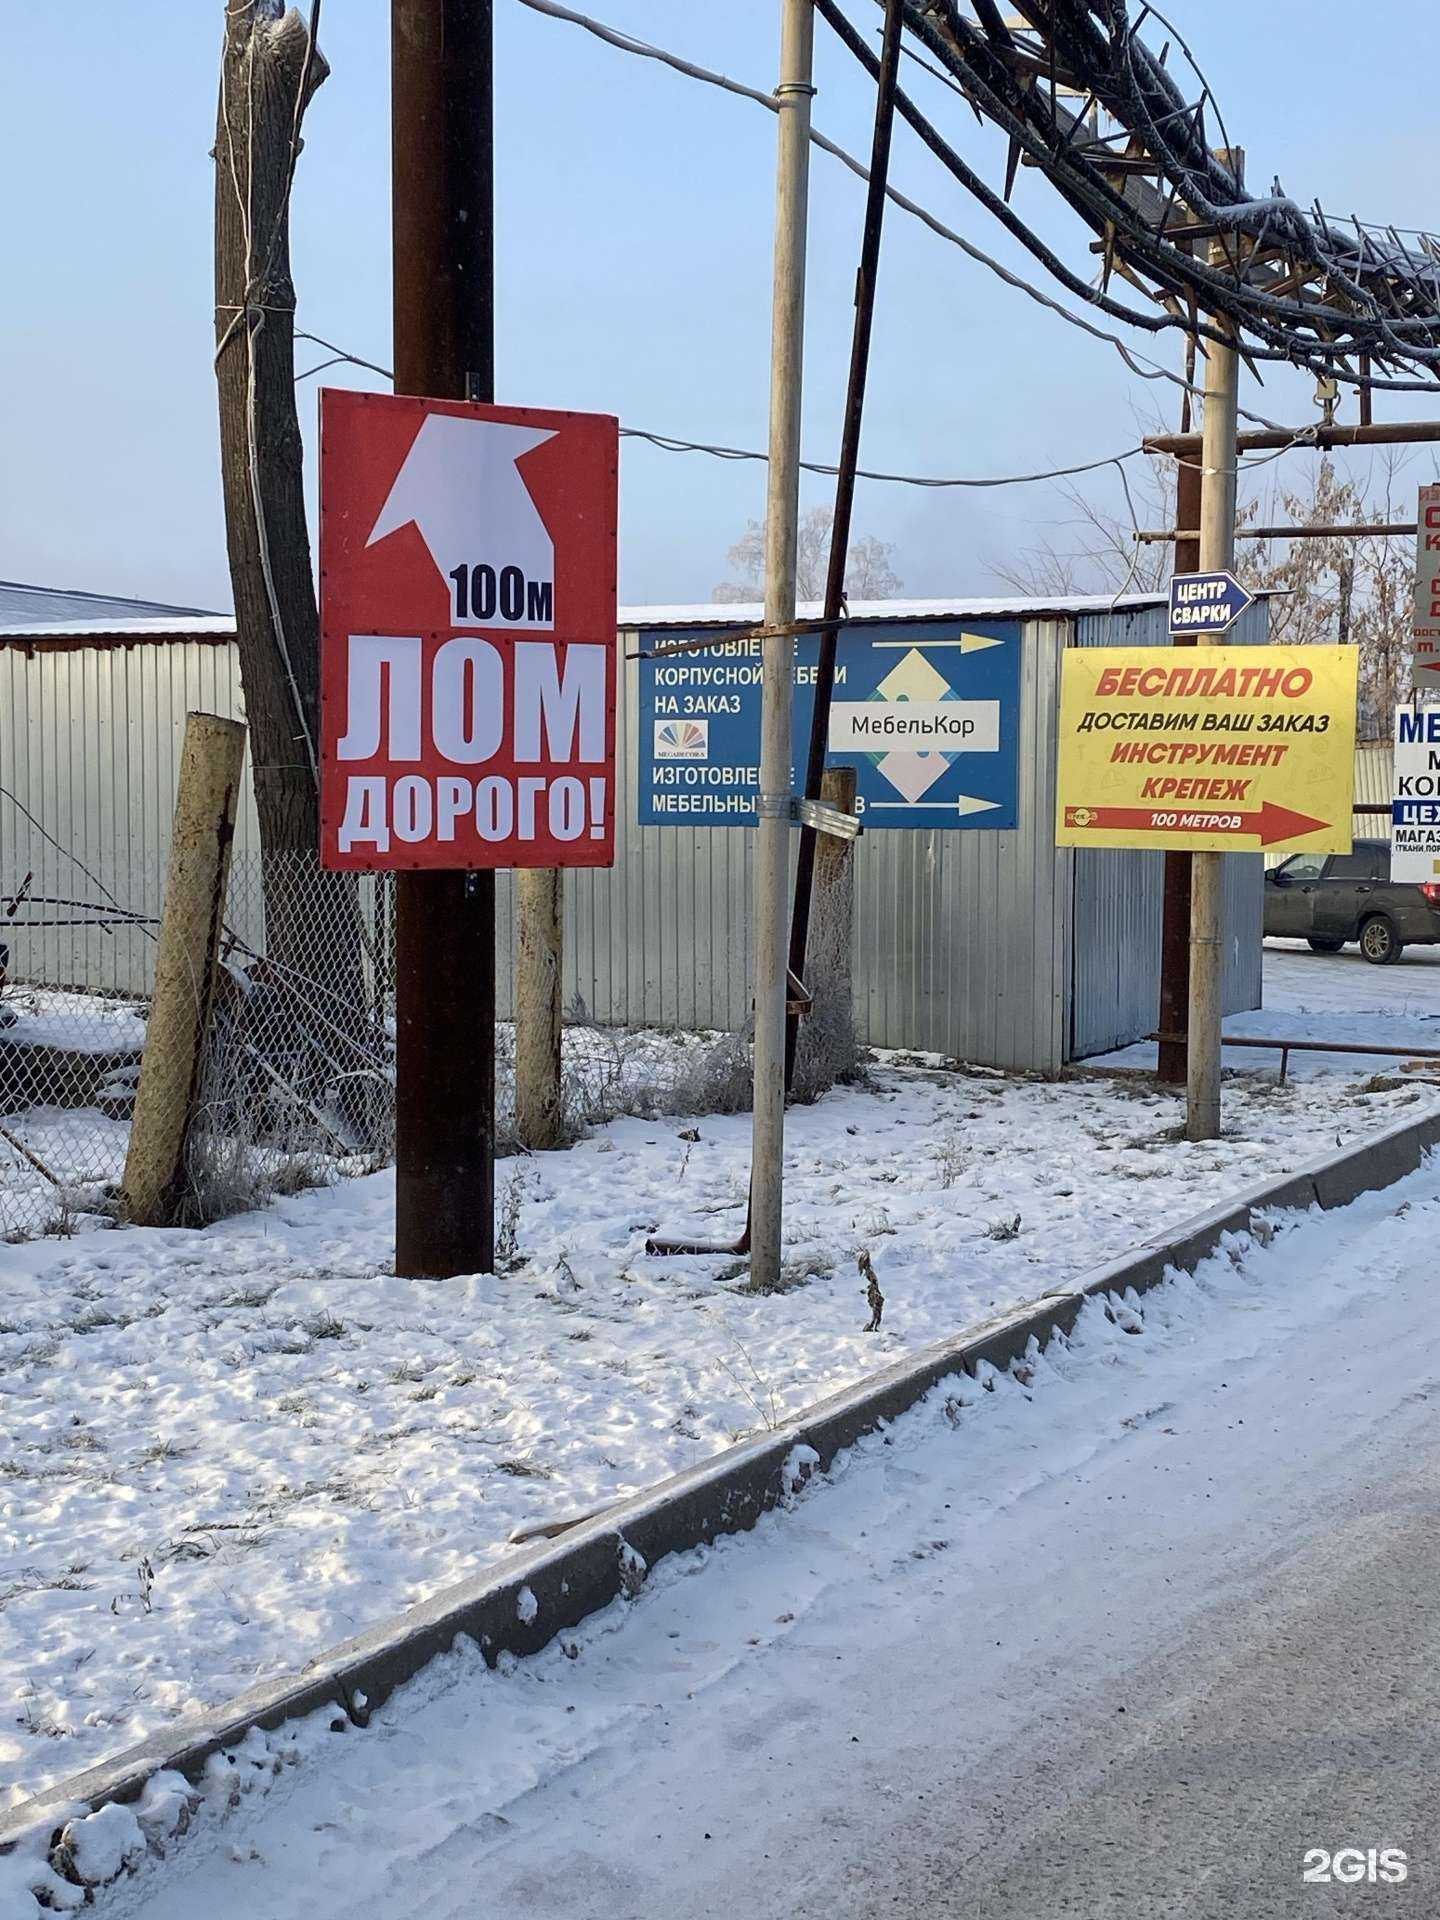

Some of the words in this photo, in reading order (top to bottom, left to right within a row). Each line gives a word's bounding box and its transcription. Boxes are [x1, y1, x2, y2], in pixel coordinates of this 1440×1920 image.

[1177, 581, 1227, 605] ЦЕНТР
[1172, 603, 1231, 625] СВАРКИ
[655, 638, 799, 657] ИЗГООВЛЕ
[655, 662, 764, 686] КОРПУСНОЙ
[1095, 667, 1313, 698] БЕСПЛАТНО
[336, 634, 607, 764] ЛОМ
[655, 695, 679, 713] НА
[684, 694, 741, 713] ЗАКАЗ
[852, 715, 975, 738] МебельКор
[1076, 712, 1199, 733] ДОСТАВИМ
[1201, 713, 1255, 732] ВАШ
[1256, 714, 1330, 733] ЗАКАЗ
[1110, 742, 1289, 767] ИНСТРУМЕНТ
[652, 767, 795, 785] ИЗГОТОВЛЕ
[1399, 776, 1440, 796] КО
[1140, 777, 1253, 800] КРЕПЕЖ
[338, 775, 606, 853] ДОРОГО!
[652, 794, 757, 813] МЕБЕЛЬНЫ
[1150, 812, 1176, 827] 100
[1179, 813, 1242, 829] МЕТРОВ
